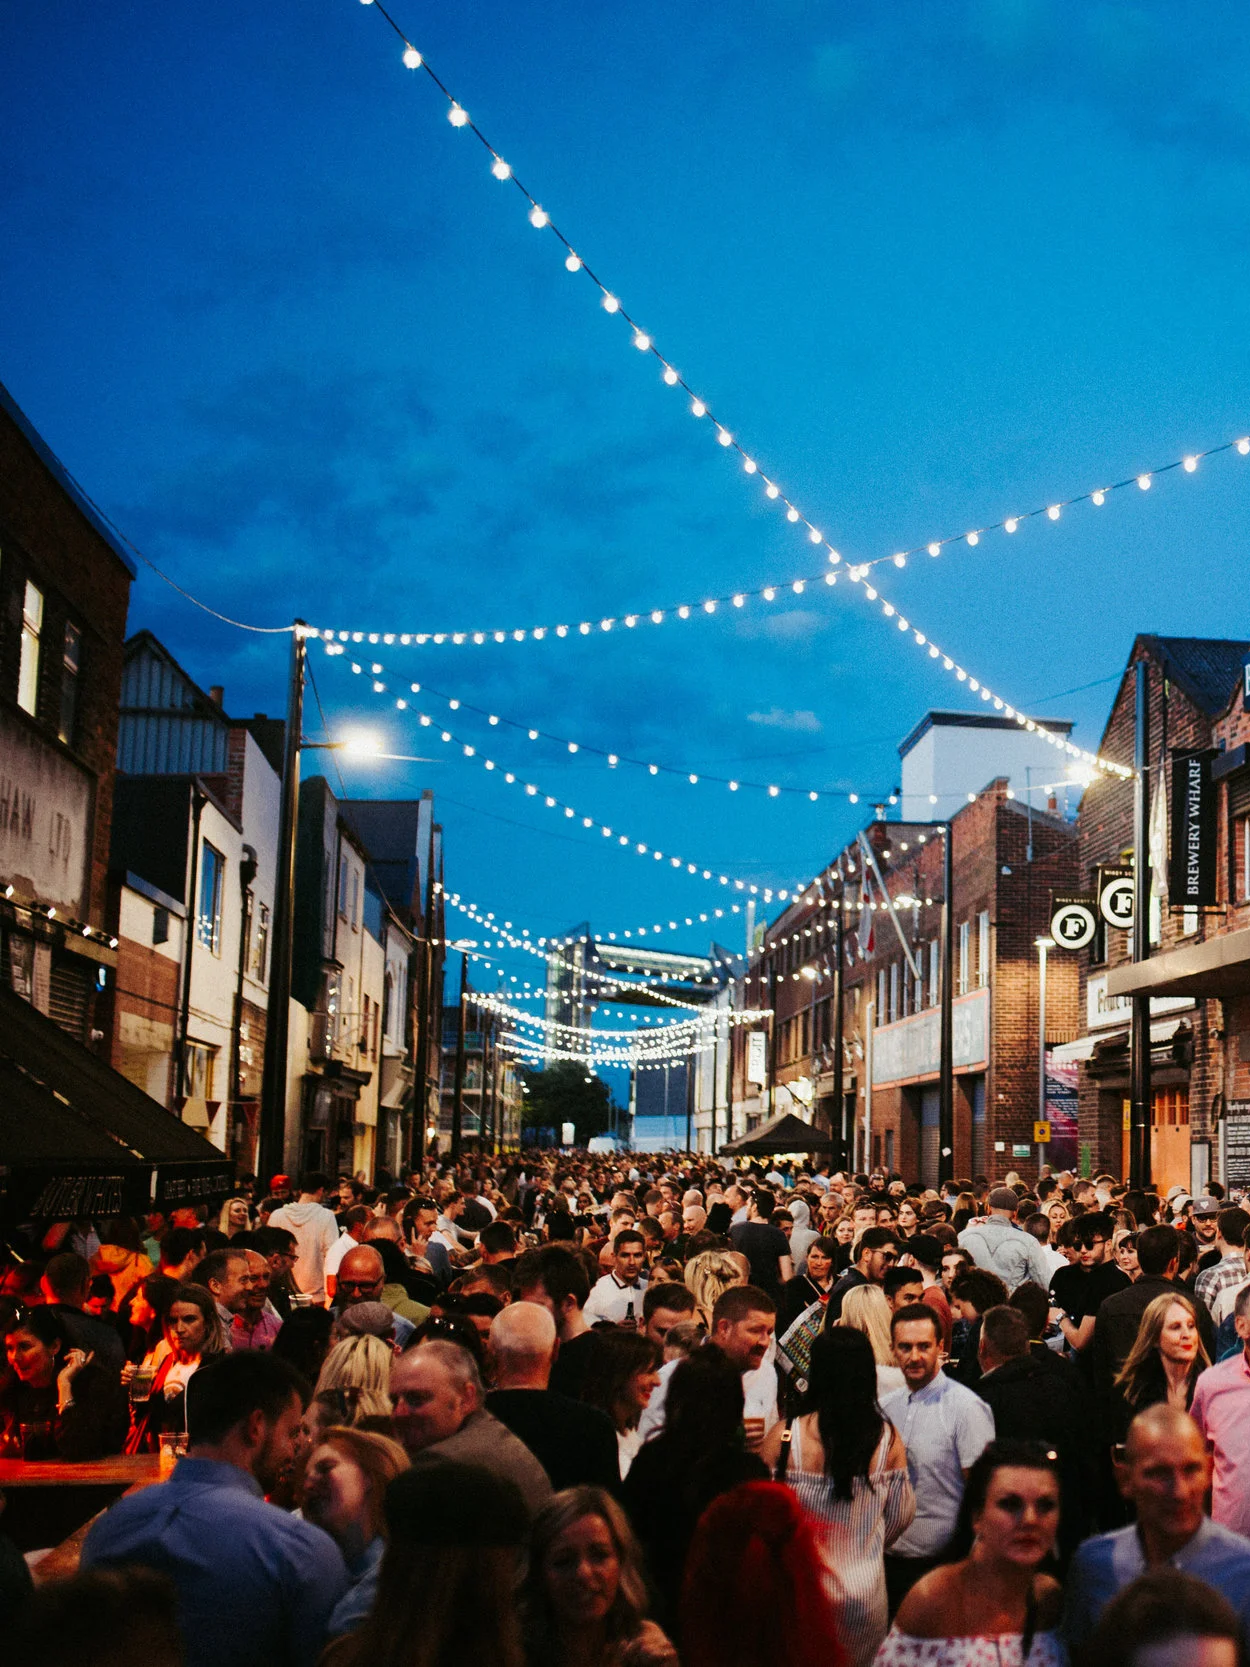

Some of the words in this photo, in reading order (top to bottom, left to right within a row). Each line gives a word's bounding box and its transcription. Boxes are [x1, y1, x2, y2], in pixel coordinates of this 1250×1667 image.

[1189, 759, 1200, 818] WHARF
[1187, 823, 1200, 895] BREWERY
[1064, 917, 1085, 937] F
